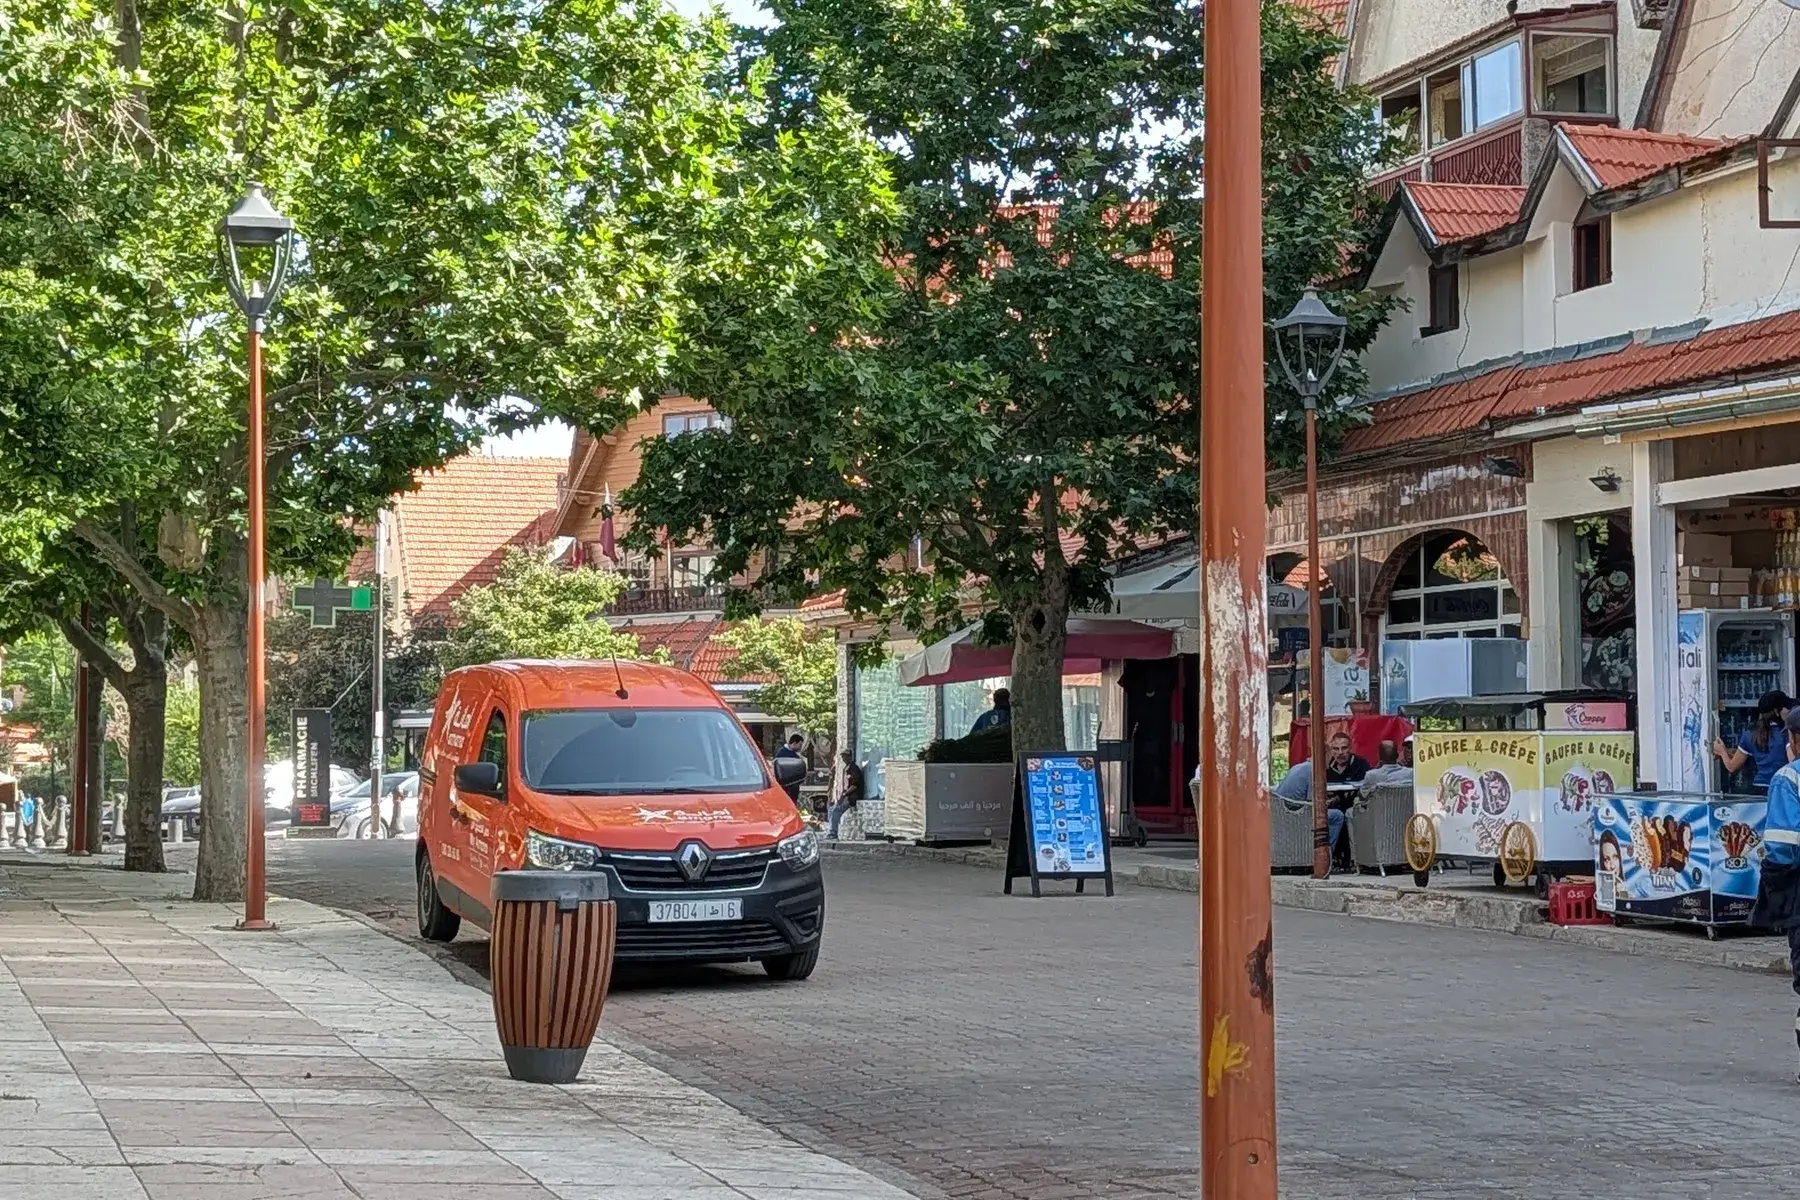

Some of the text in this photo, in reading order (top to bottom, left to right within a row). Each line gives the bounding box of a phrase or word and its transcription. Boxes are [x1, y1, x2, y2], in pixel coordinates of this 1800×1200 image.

[296, 716, 308, 799] PHARMACIE
[1418, 739, 1537, 765] GAUFRE & CRÊPE
[1544, 742, 1632, 765] GAUFRE & CRÊPE
[310, 742, 319, 798] MICHLIFEN
[655, 903, 698, 920] 37804
[727, 902, 736, 919] 6
